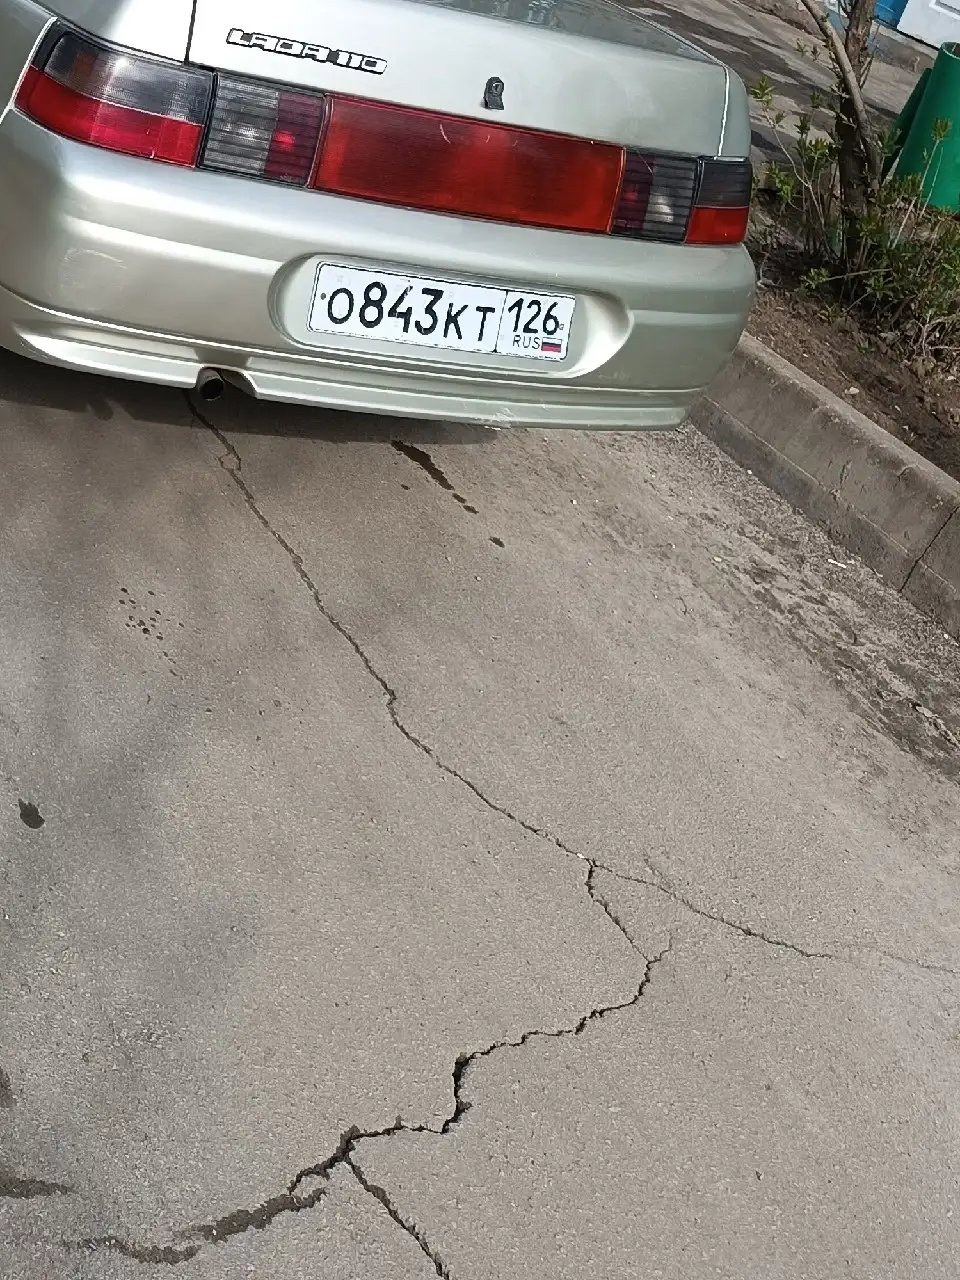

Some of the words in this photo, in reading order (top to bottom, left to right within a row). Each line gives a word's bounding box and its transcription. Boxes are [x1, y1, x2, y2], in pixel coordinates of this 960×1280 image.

[226, 28, 331, 63] LADA
[332, 49, 388, 74] 110
[507, 297, 559, 336] 126
[512, 334, 541, 350] RUS
